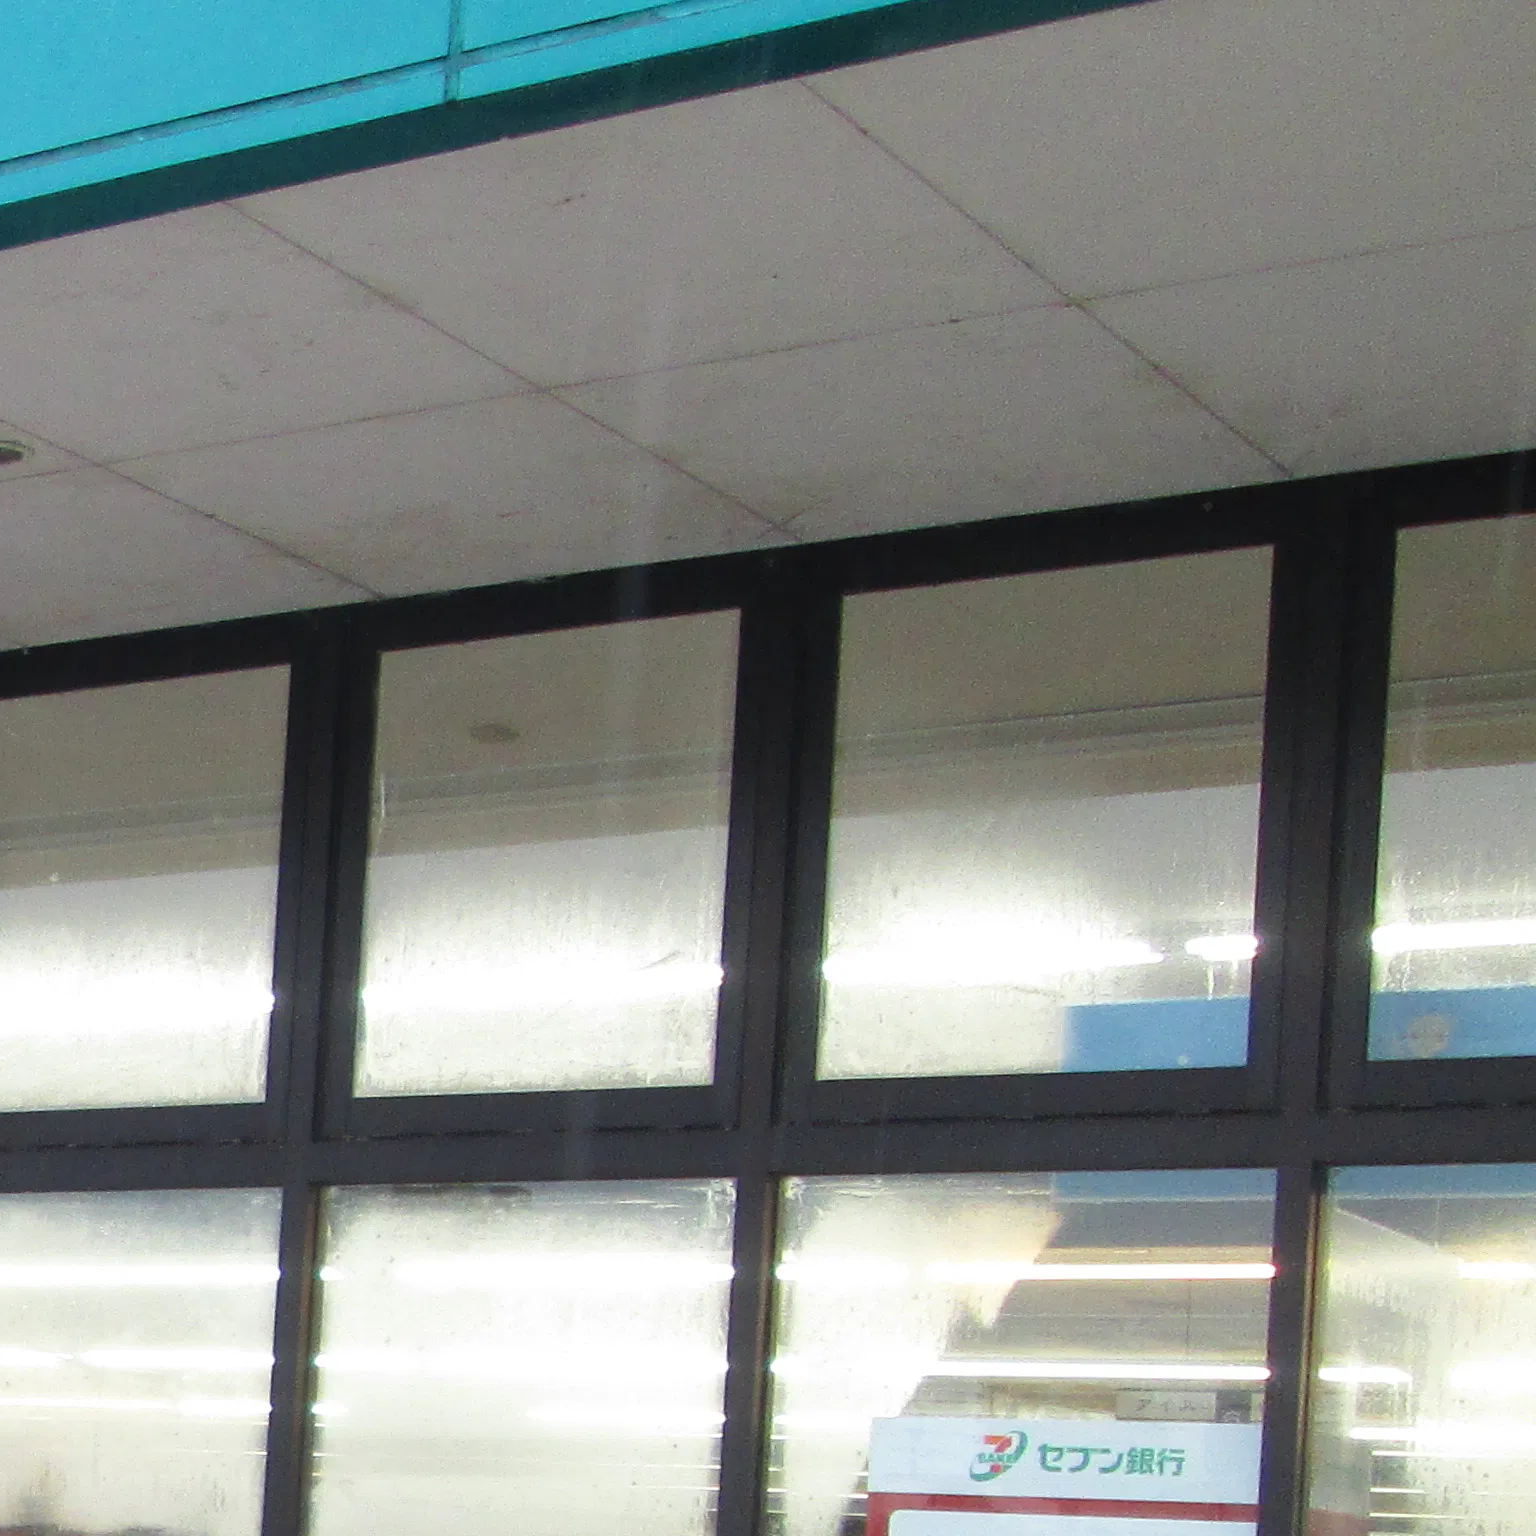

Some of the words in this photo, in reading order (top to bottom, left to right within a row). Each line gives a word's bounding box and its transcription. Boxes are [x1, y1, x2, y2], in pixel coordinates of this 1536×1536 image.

[1037, 1443, 1186, 1476] セブン銀行
